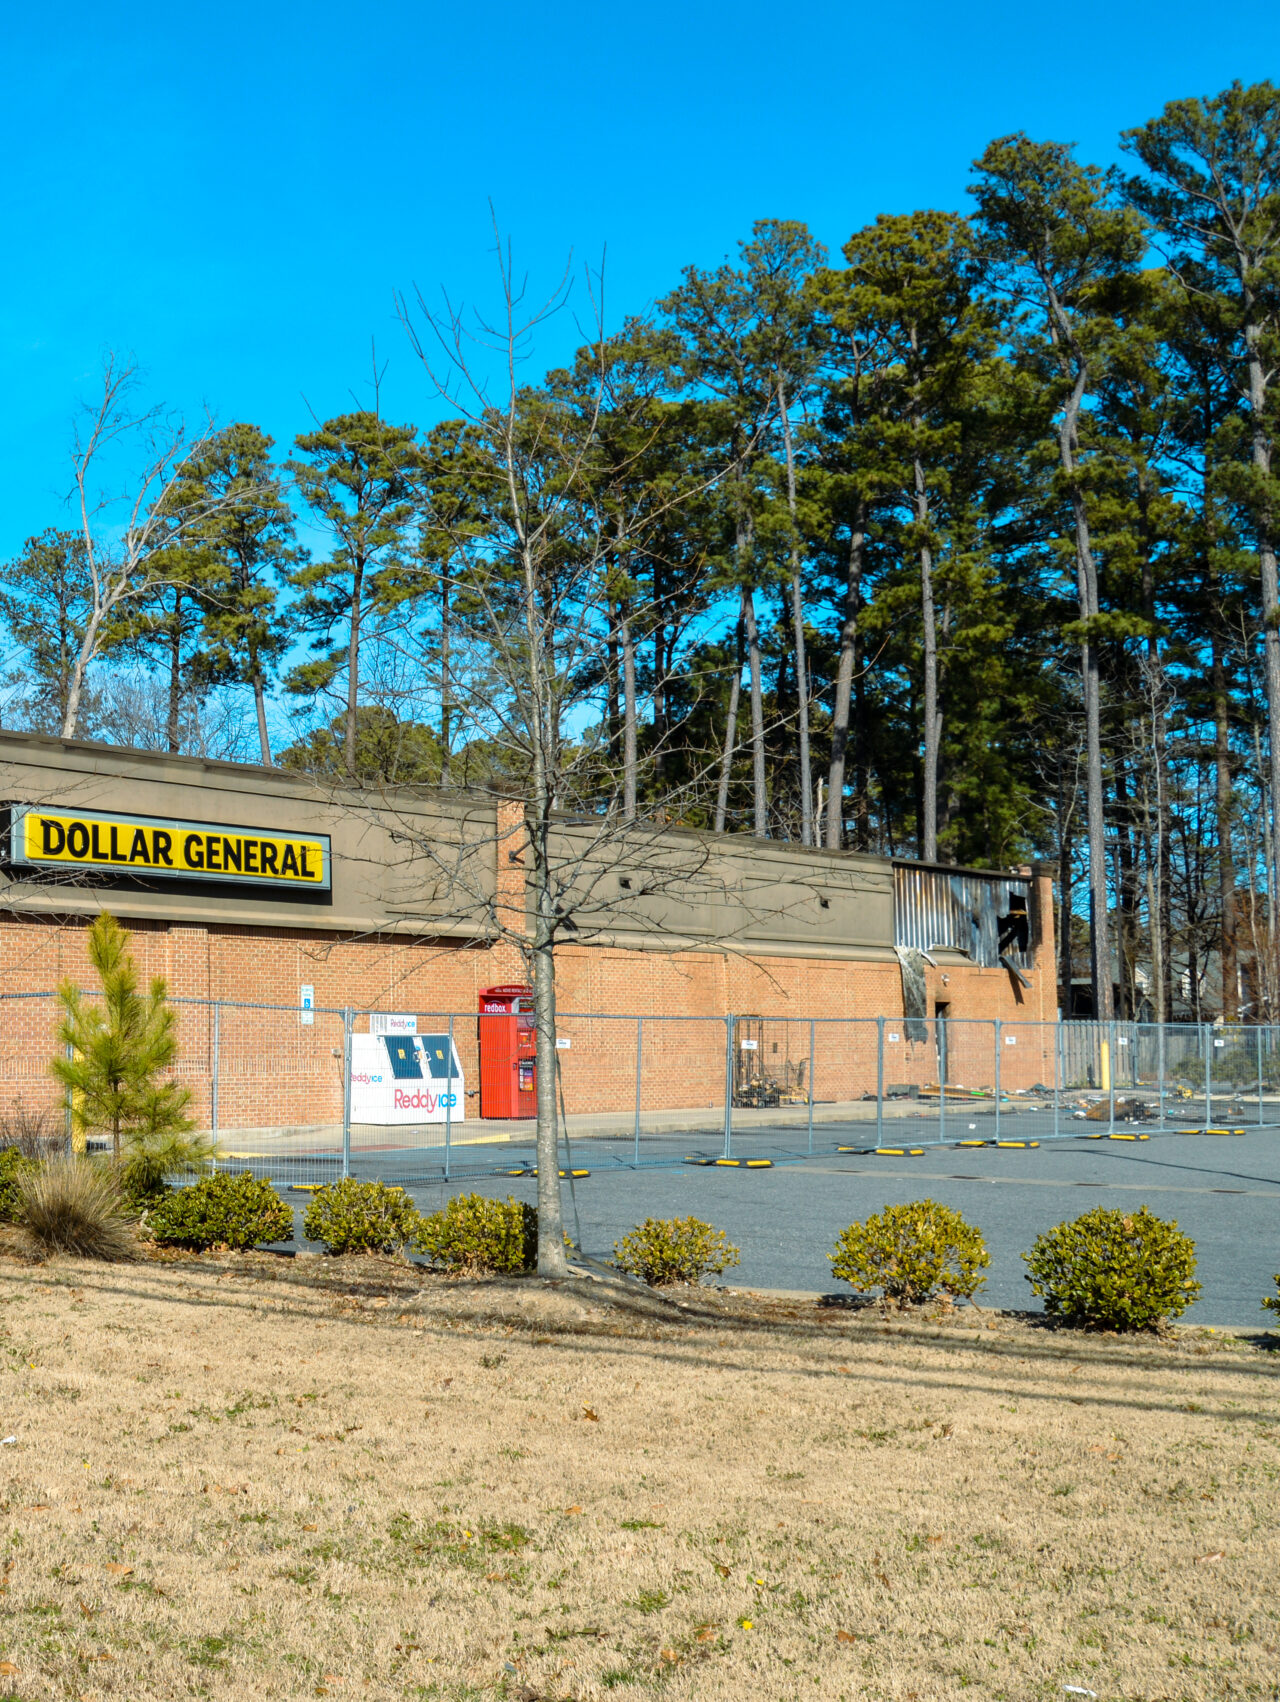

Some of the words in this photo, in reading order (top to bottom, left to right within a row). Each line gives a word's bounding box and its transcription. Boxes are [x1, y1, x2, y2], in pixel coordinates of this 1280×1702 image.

[40, 819, 174, 867] DOLLAR
[184, 834, 315, 878] GENERAL
[484, 1002, 506, 1013] redbox
